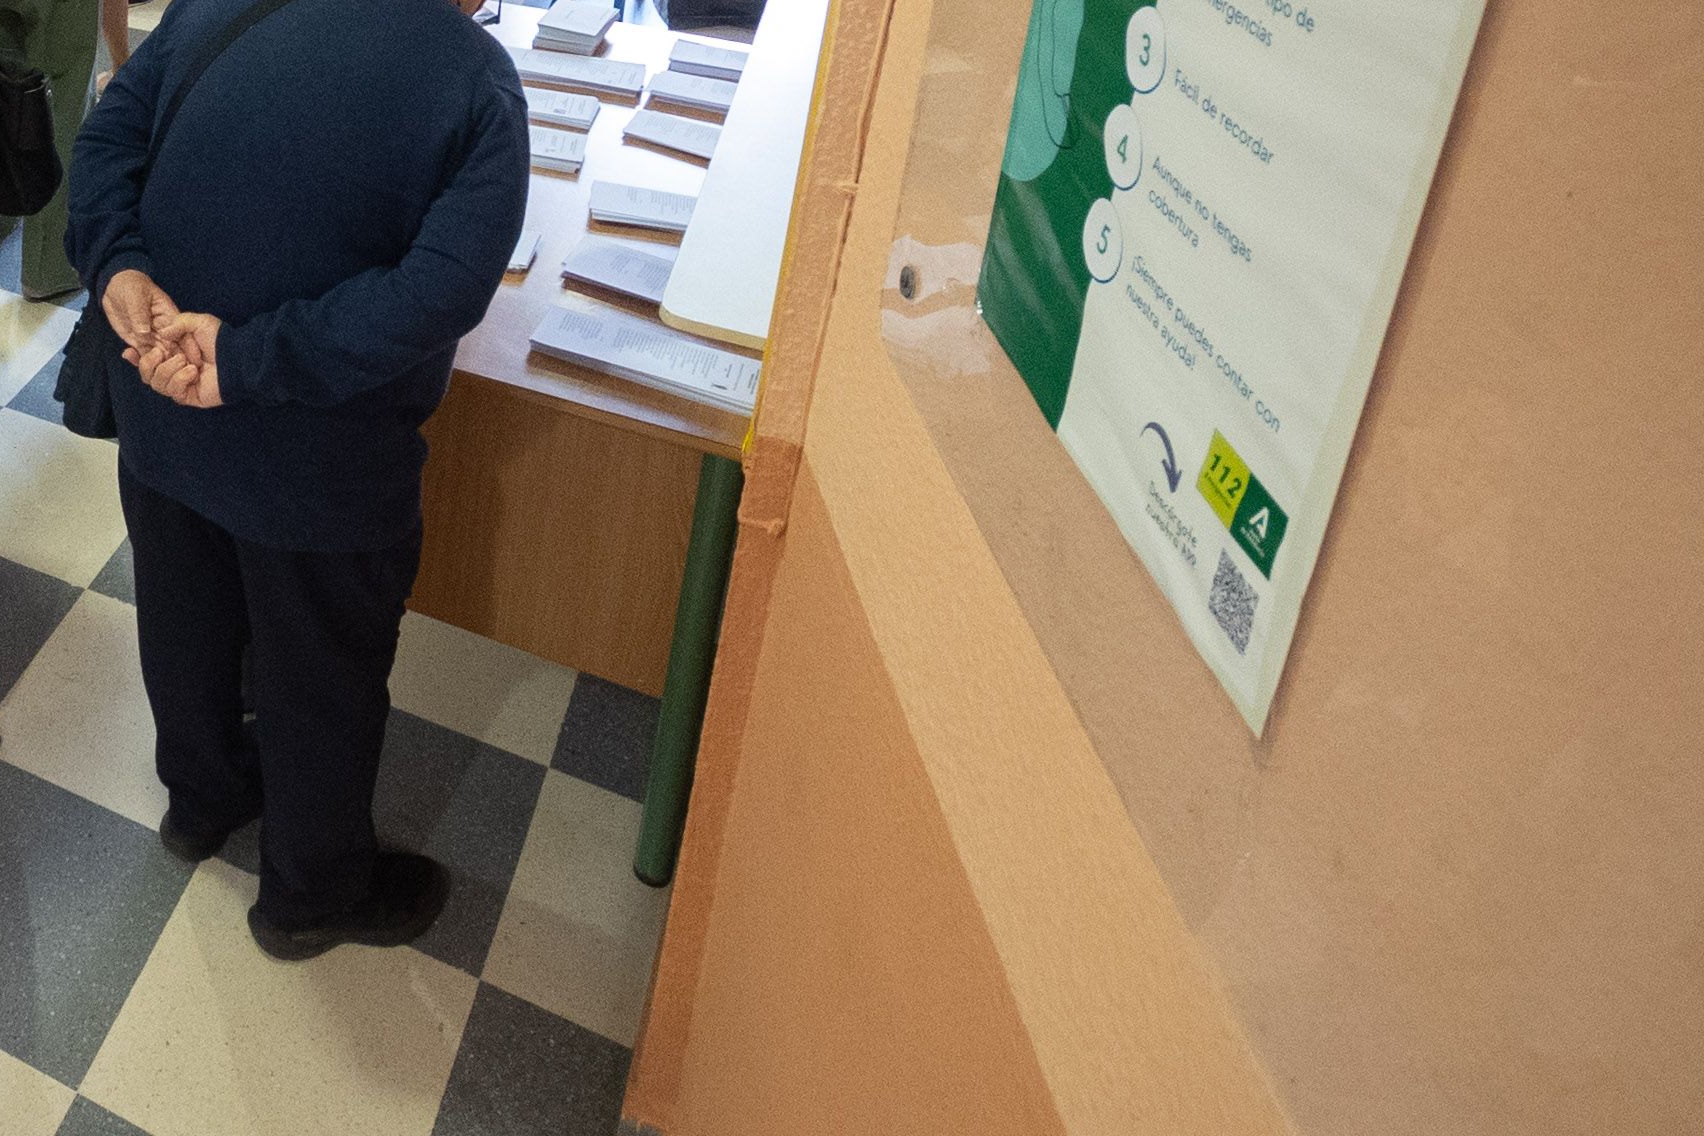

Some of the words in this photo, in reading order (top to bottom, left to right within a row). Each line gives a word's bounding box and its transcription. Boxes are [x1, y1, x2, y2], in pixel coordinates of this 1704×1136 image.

[1296, 7, 1316, 33] de
[1139, 33, 1152, 66] 3
[1174, 68, 1201, 105] Fácil
[1202, 96, 1218, 118] de
[1219, 113, 1275, 164] recordar
[1117, 134, 1129, 164] 4
[1148, 189, 1200, 249] cobertura
[1152, 156, 1193, 205] Aunque
[1194, 198, 1210, 221] no
[1212, 213, 1253, 263] tengas
[1096, 224, 1111, 255] 5
[1126, 283, 1160, 329] nuestra
[1160, 325, 1197, 371] ayuda!
[1175, 307, 1215, 358] puedes
[1214, 353, 1254, 401] contar
[1255, 399, 1281, 433] con
[1208, 452, 1243, 499] 112
